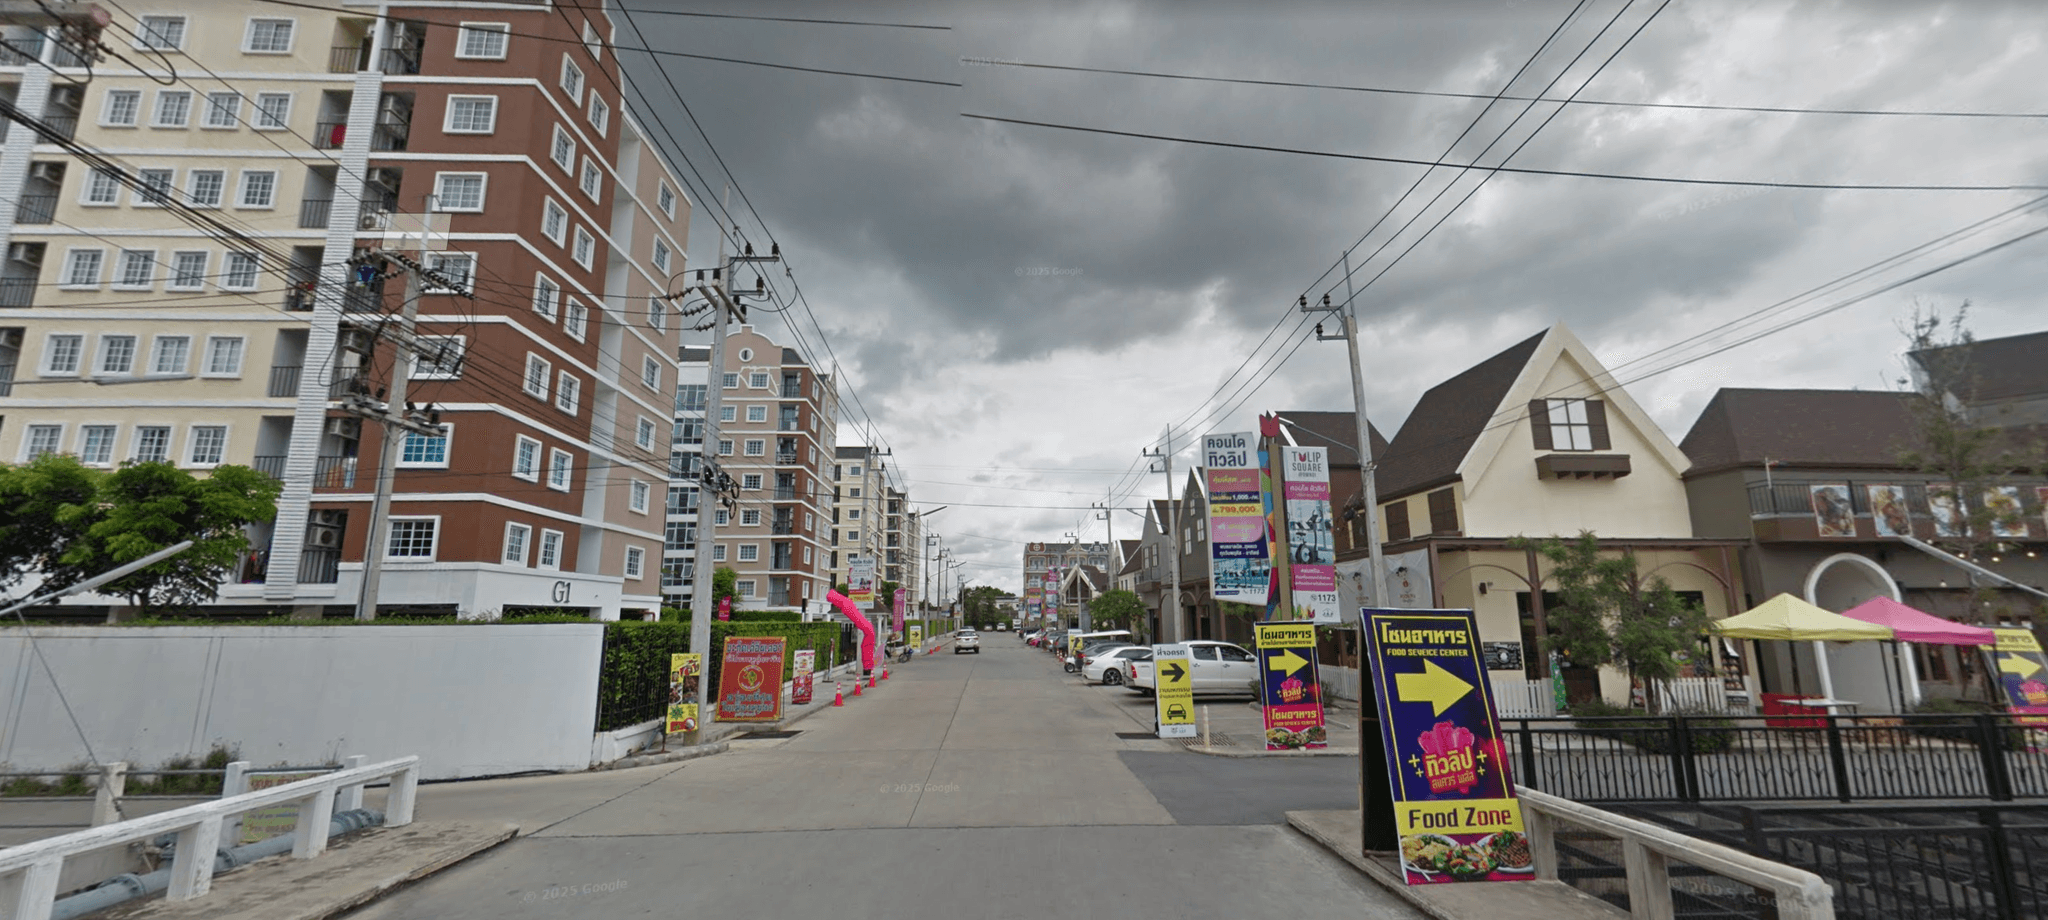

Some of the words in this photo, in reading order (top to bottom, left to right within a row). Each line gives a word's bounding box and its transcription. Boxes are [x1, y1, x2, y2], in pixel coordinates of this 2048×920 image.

[1207, 434, 1246, 448] คอนโด
[1208, 451, 1247, 467] ทิวลิป
[1292, 451, 1321, 462] TULIP
[1292, 462, 1322, 472] SQUARE
[552, 580, 572, 604] G1
[1260, 628, 1312, 640] โซนอาหาร
[1380, 622, 1467, 644] โซนอาหาร
[1157, 647, 1185, 656] ที่จอดรถ
[1440, 648, 1469, 657] CENTER
[1272, 708, 1317, 720] โซนอาหาร
[1426, 746, 1473, 777] ทิวลิป
[1409, 808, 1458, 829] Food
[1465, 807, 1512, 827] Zone
